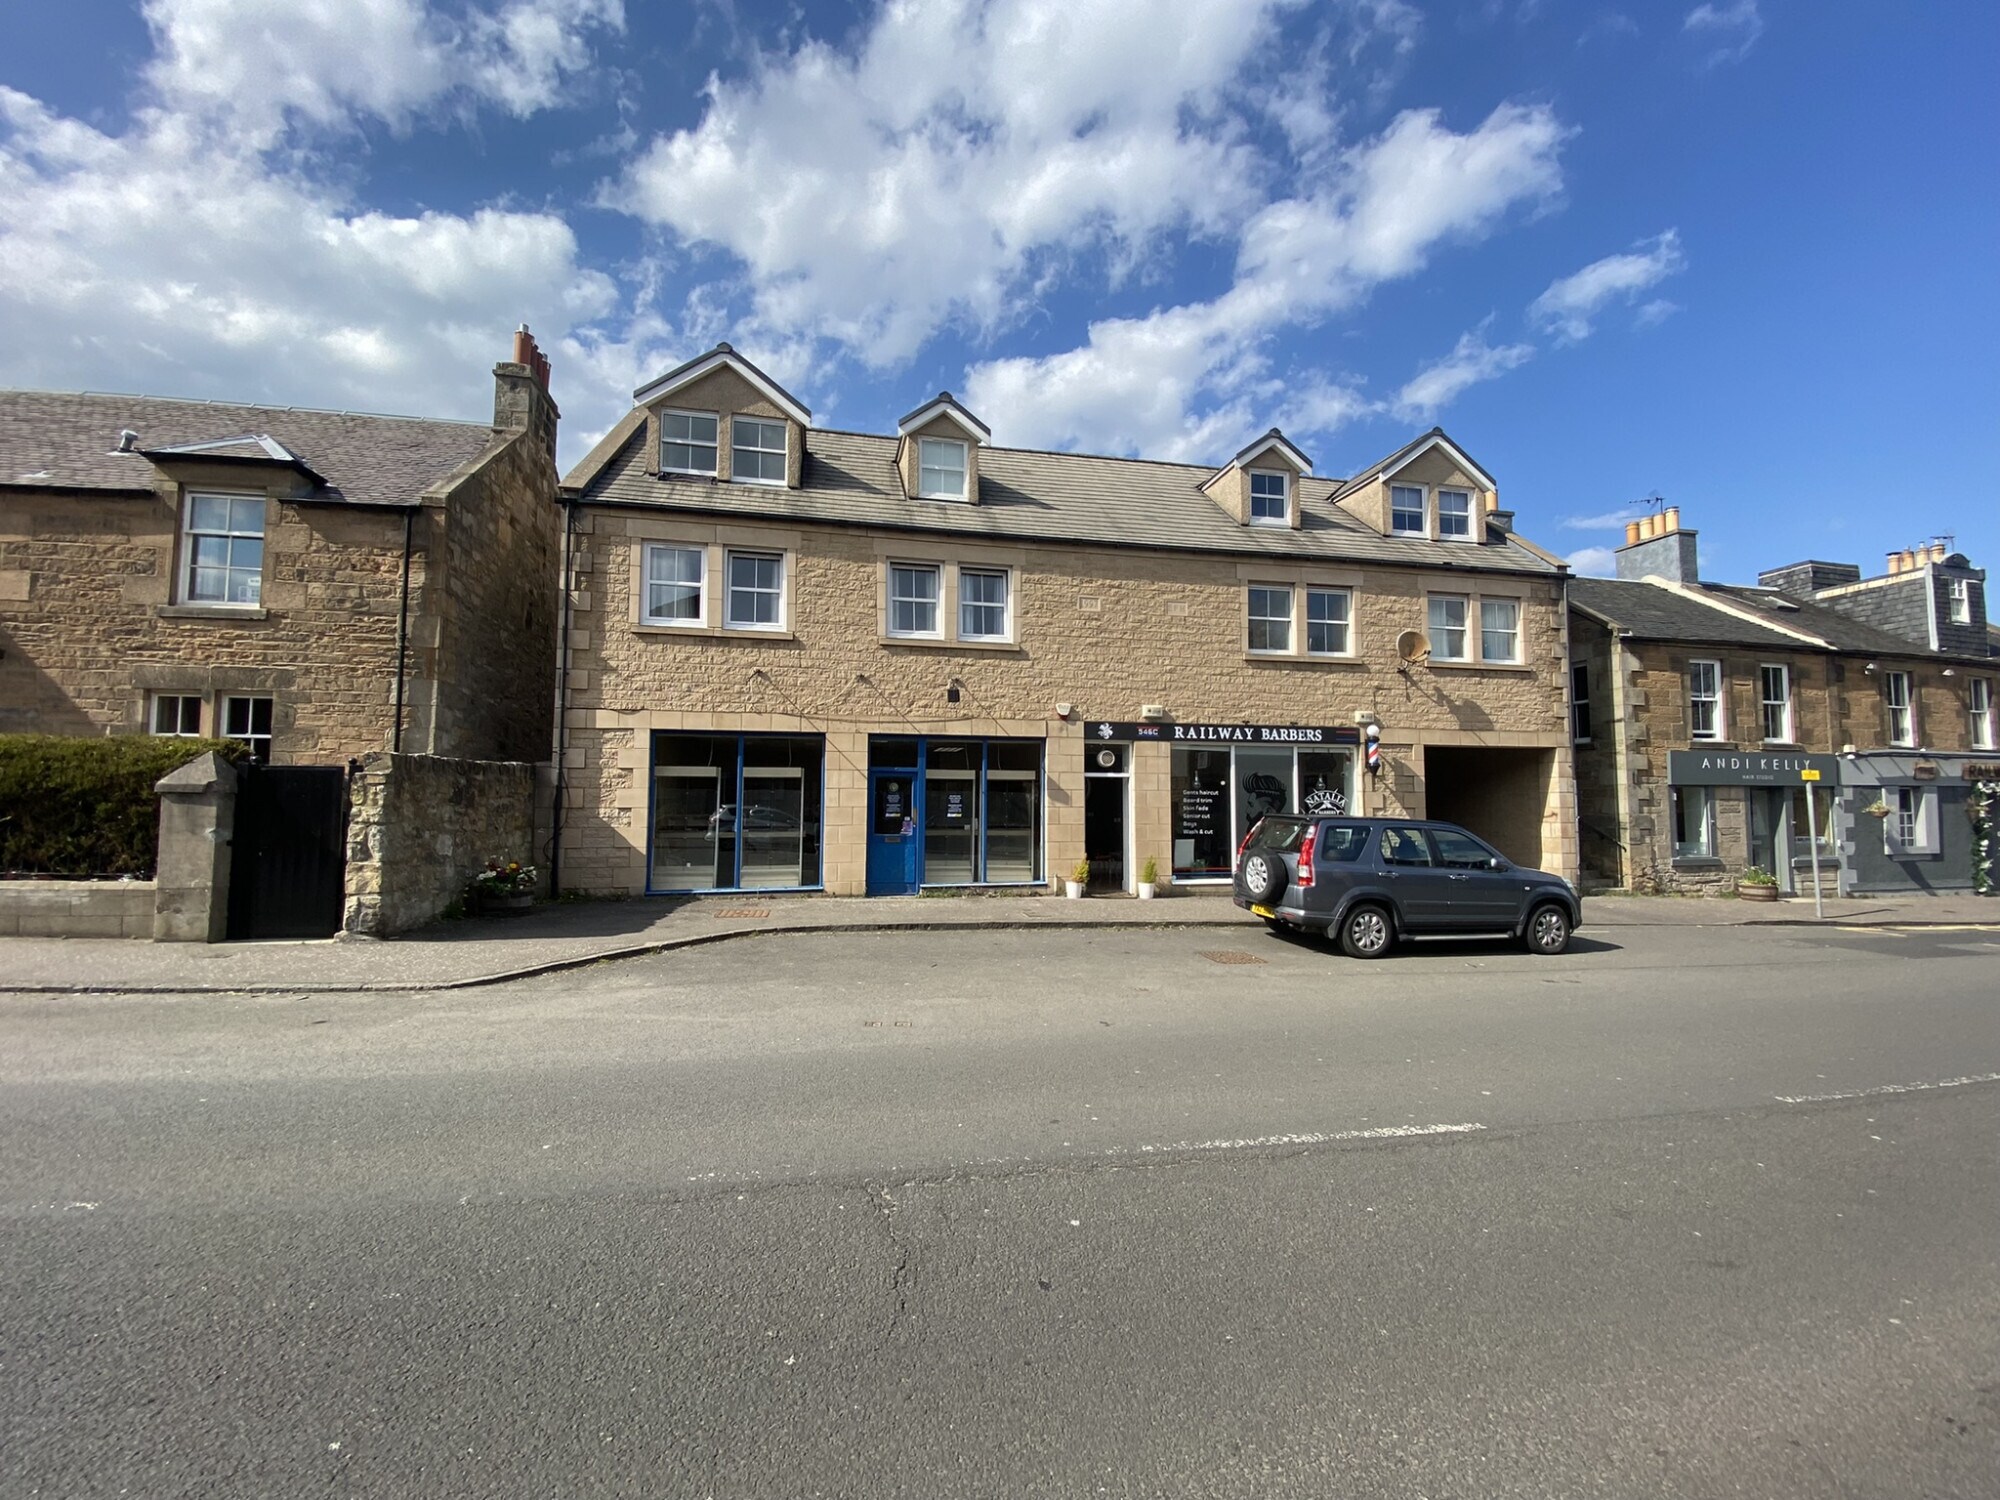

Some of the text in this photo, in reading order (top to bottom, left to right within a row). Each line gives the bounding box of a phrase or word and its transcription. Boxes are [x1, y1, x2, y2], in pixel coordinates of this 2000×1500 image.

[1174, 726, 1322, 741] RAILWAY BARBERS
[1702, 758, 1810, 771] ANDI KELLY
[1305, 791, 1346, 808] NATALIA
